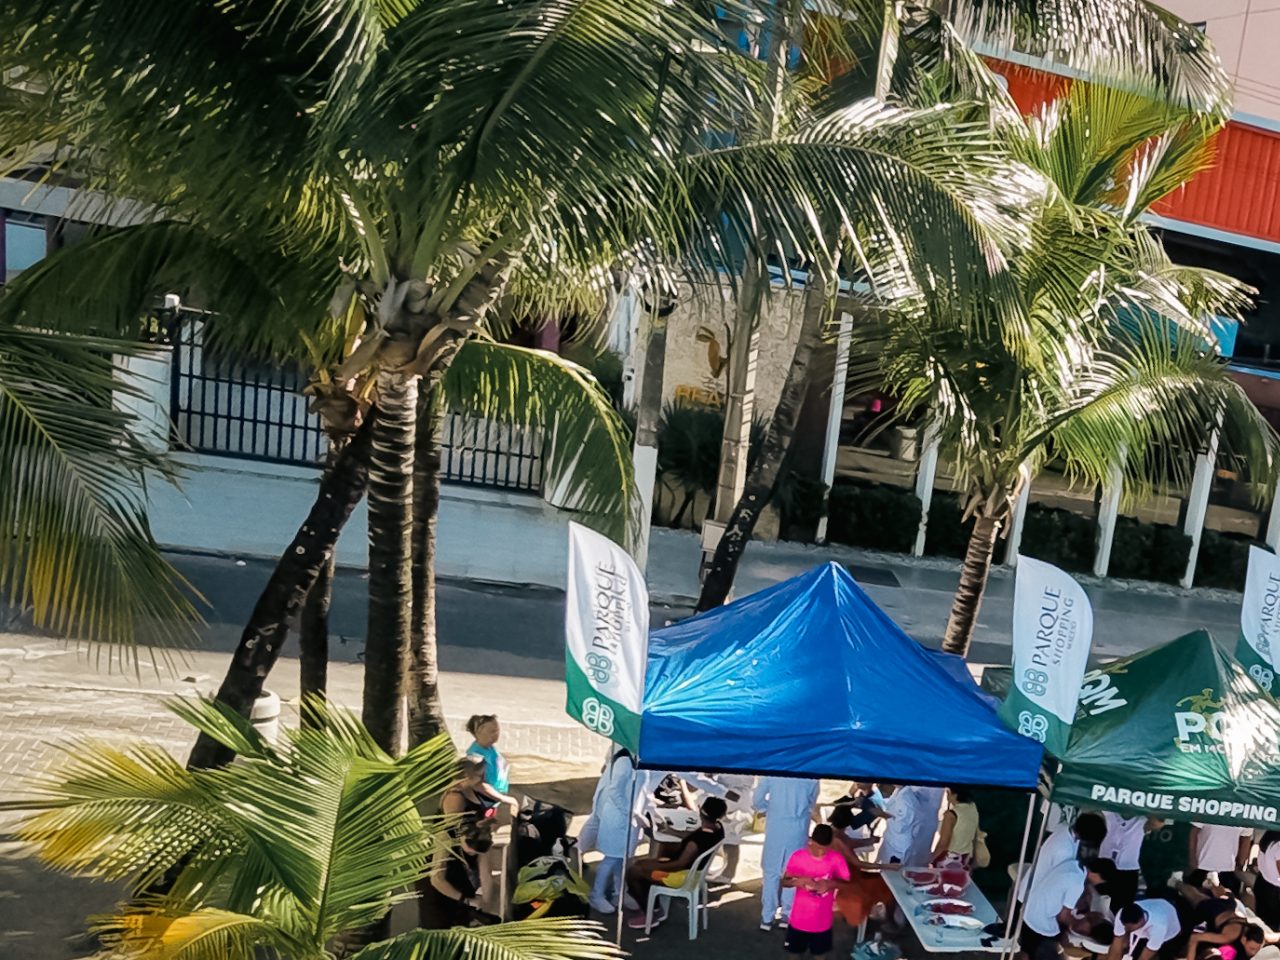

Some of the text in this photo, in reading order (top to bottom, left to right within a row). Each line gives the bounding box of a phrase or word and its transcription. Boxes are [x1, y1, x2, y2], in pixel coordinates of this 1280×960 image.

[1031, 585, 1062, 668] PARQUE
[1052, 597, 1074, 667] SHOPPING
[1091, 784, 1174, 811] PARQUE
[1178, 796, 1278, 823] SHOPPING
